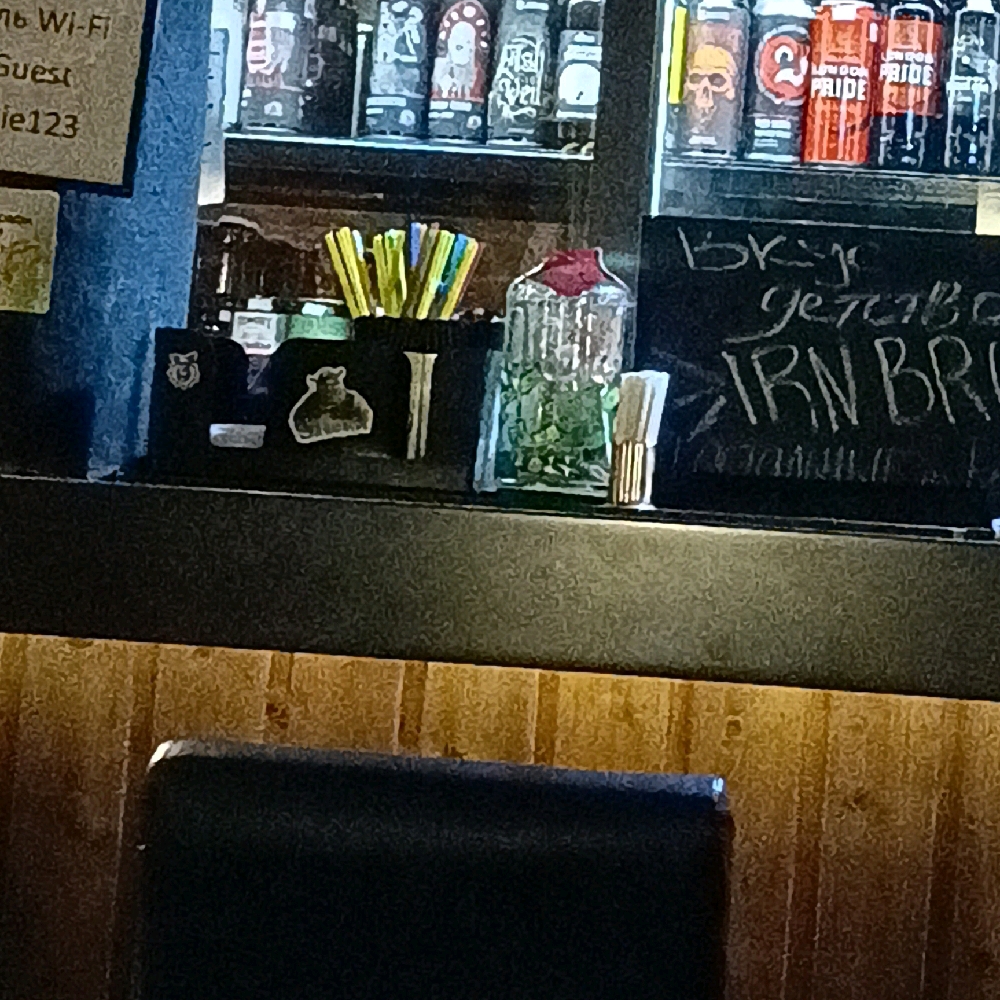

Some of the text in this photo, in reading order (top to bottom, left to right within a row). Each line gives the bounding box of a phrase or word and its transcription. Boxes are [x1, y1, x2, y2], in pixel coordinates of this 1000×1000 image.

[37, 6, 112, 40] Wi-Fi
[811, 76, 868, 101] PRIDE
[879, 62, 935, 88] PRIDE
[720, 342, 860, 433] IRN
